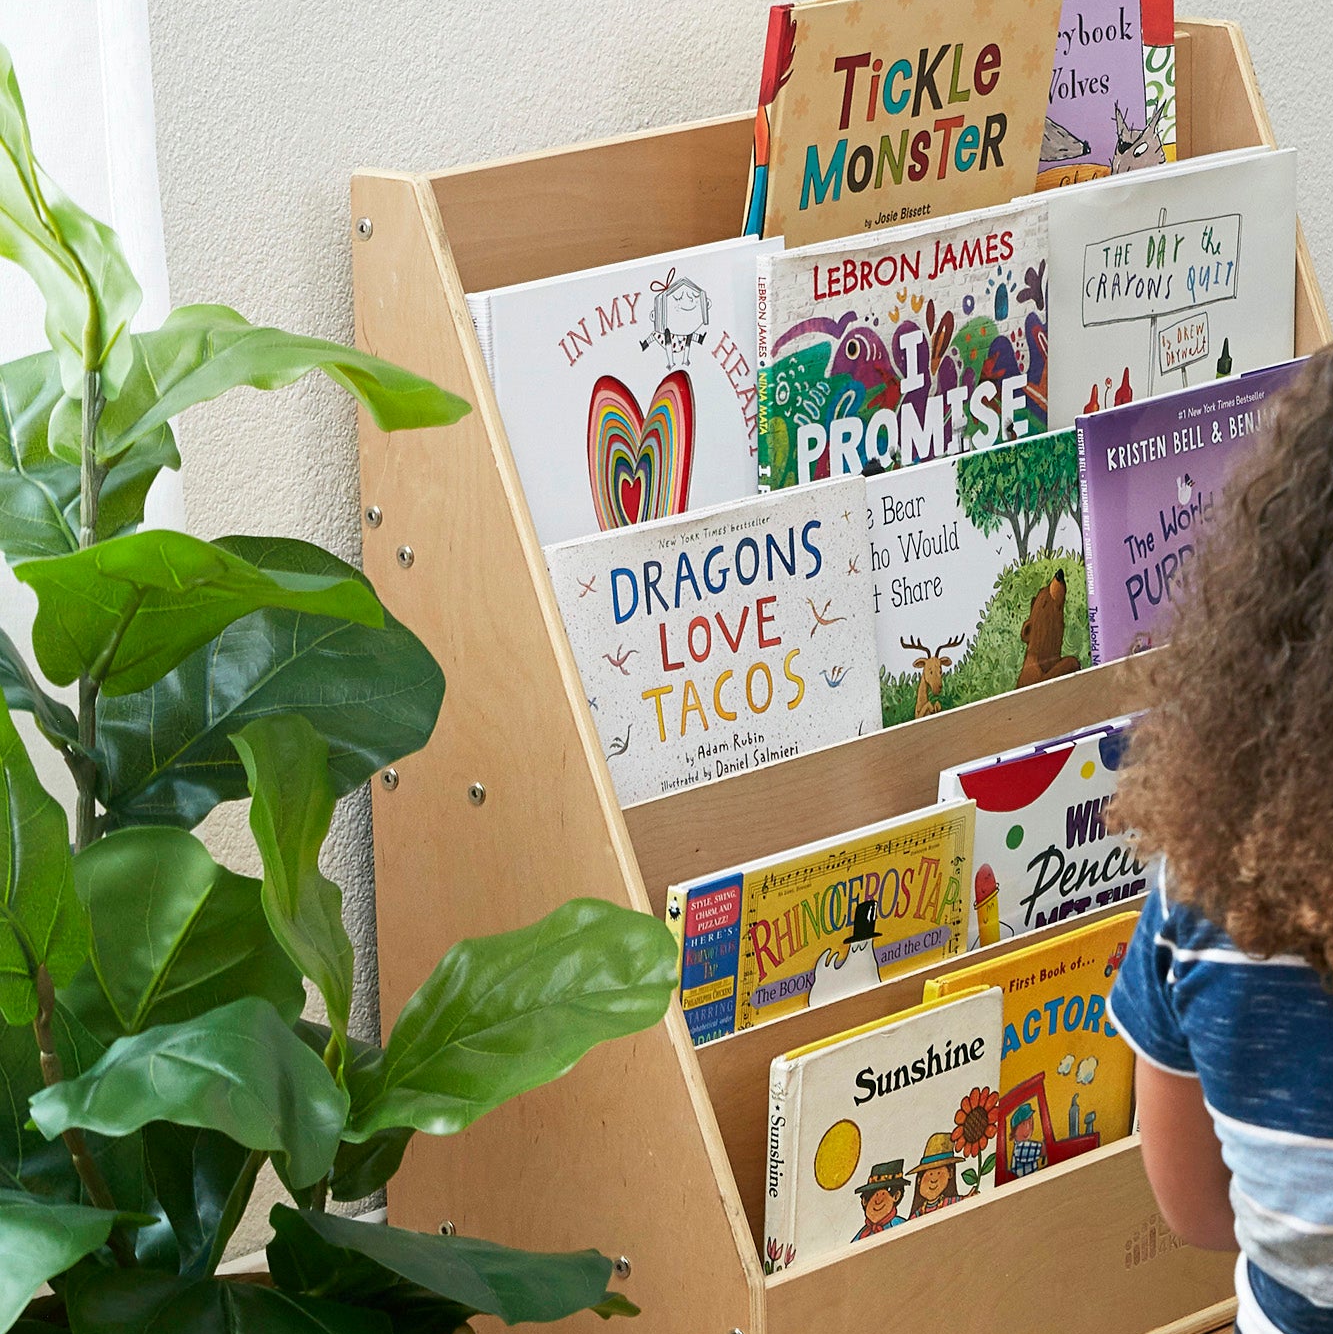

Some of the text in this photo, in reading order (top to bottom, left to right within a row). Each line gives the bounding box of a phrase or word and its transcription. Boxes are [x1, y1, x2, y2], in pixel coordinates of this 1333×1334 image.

[864, 203, 932, 228] by Josie Bissett
[1102, 224, 1222, 271] THE DAY the
[813, 230, 1015, 302] LEBRON JAMES
[1085, 259, 1235, 303] CRAYONS QUIT
[758, 277, 768, 320] LEBRON
[557, 318, 594, 367] IN
[594, 291, 642, 337] MY
[758, 322, 768, 358] JAMES
[1177, 322, 1205, 344] DREW
[899, 328, 927, 395] I
[758, 372, 768, 402] NINA
[758, 405, 769, 435] MATA
[1178, 391, 1265, 420] #1 New York Times Bestseller
[797, 373, 1029, 483] PROMISE
[1106, 434, 1167, 471] KRISTEN
[1172, 425, 1205, 455] BELL
[1211, 421, 1222, 444] &
[730, 516, 771, 532] bestseller
[881, 494, 925, 526] Bear
[870, 521, 960, 572] ho Would
[1124, 532, 1155, 564] The
[610, 519, 823, 625] DRAGONS
[891, 575, 943, 608] Share
[1089, 606, 1098, 624] The
[659, 595, 782, 672] LOVE
[1090, 625, 1100, 652] World
[641, 648, 806, 743] TACOS
[660, 741, 800, 793] illustrated by Daniel Salmieri
[685, 732, 765, 767] by Adam Rubin
[697, 915, 729, 932] PIZZAZZ!
[719, 902, 732, 914] AND
[750, 856, 961, 982] RHINOCEROS TAP
[691, 928, 733, 948] HERE'S
[881, 929, 943, 962] and the CD!
[755, 985, 777, 1006] The
[778, 971, 814, 998] BOOK
[1009, 973, 1036, 993] First
[1039, 962, 1066, 982] Book
[688, 1000, 733, 1025] TARRING
[1001, 994, 1119, 1061] ACTOR
[853, 1035, 986, 1107] Sunshine
[768, 1115, 786, 1198] Sunshine
